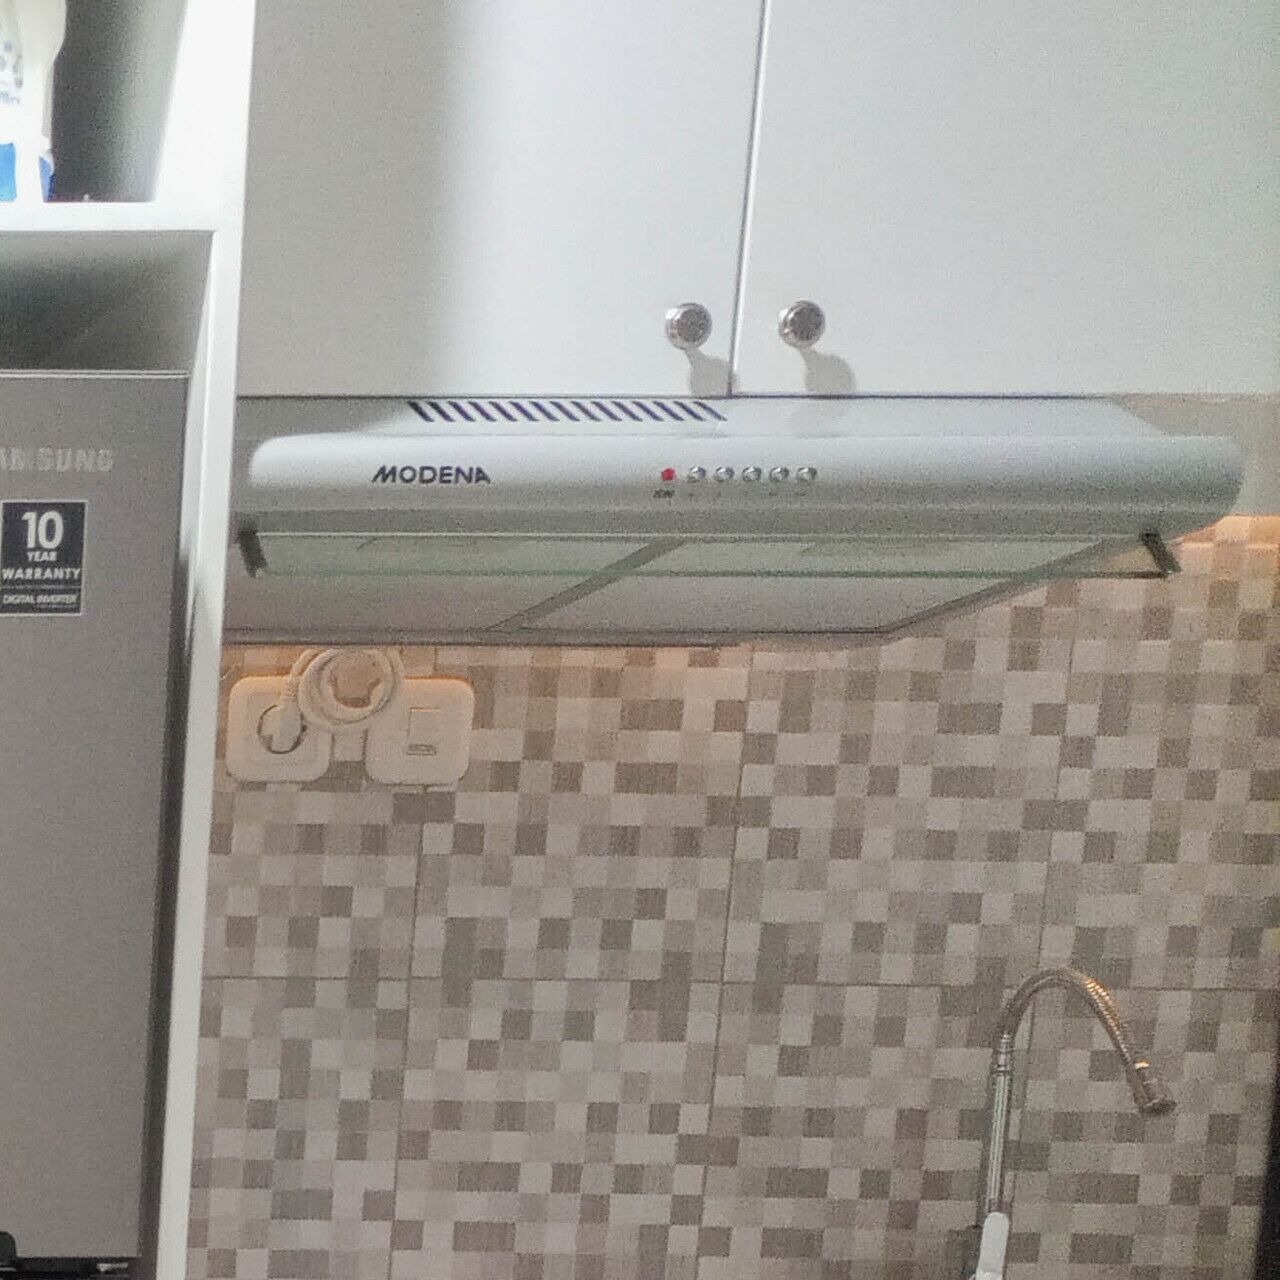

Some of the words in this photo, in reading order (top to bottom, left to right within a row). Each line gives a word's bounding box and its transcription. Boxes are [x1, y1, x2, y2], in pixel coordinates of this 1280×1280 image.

[371, 465, 491, 484] MODENA
[21, 510, 64, 549] 10
[27, 551, 57, 562] YEAR
[1, 567, 81, 580] WARRANTY
